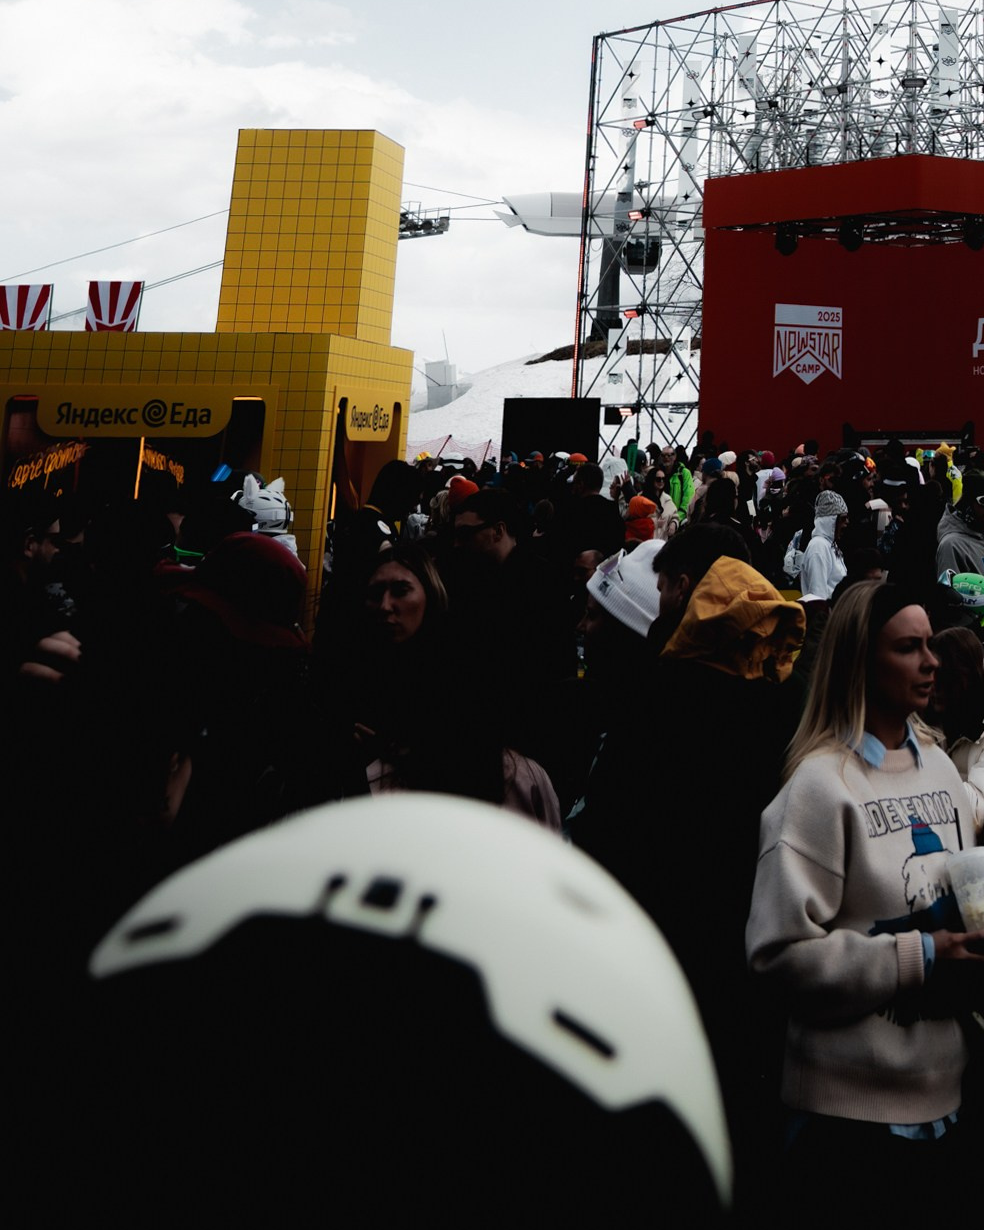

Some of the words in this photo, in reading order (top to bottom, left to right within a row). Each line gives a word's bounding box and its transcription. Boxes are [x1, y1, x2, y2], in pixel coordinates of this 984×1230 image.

[817, 311, 841, 323] 2025
[795, 363, 821, 374] CAMP
[56, 402, 138, 428] Яндекс
[170, 402, 211, 428] Еда
[351, 405, 372, 431] Яндекс
[379, 407, 389, 431] Еда
[952, 582, 982, 591] oPro
